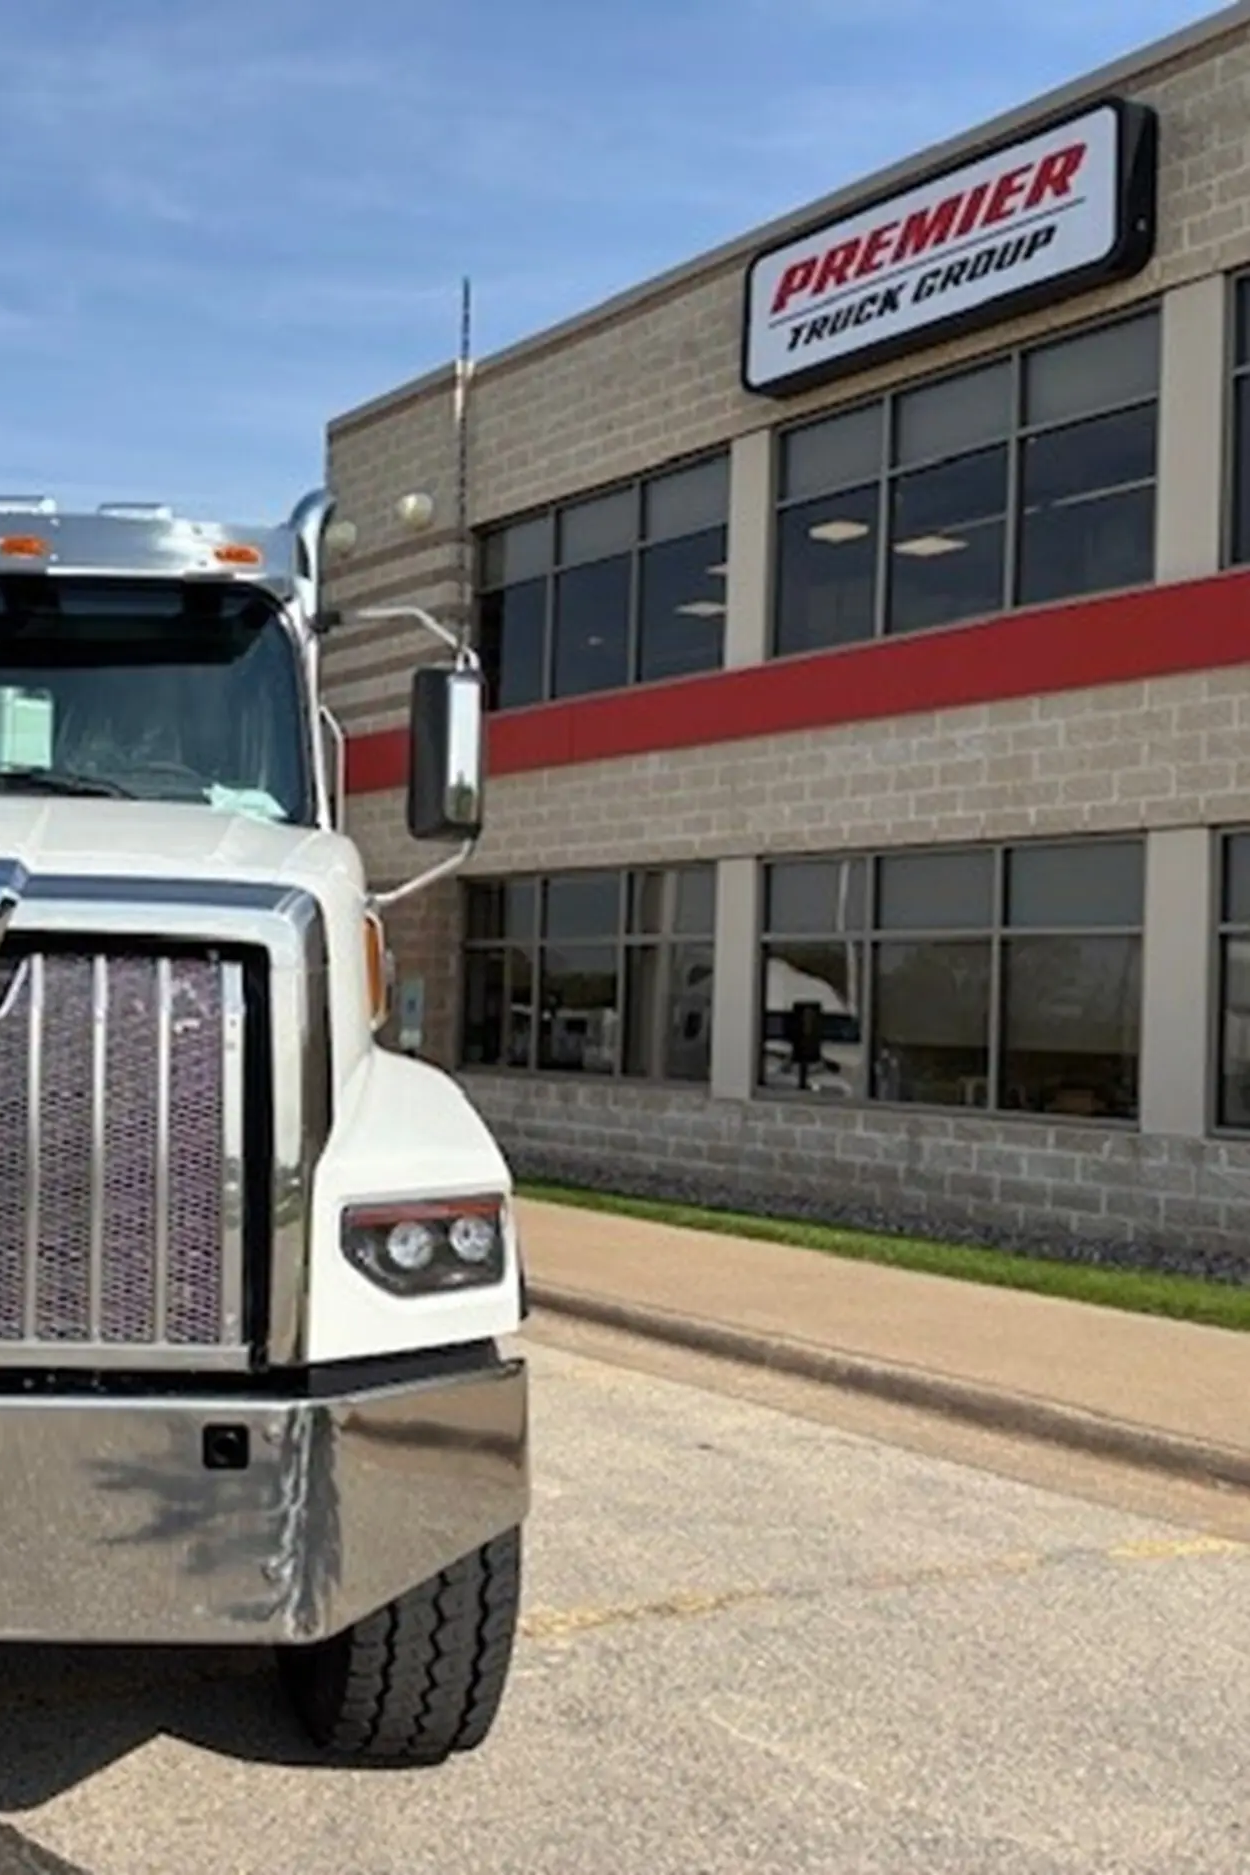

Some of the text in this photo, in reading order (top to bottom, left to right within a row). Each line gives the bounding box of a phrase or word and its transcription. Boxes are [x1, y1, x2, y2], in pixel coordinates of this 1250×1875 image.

[770, 142, 1087, 314] PREMIER
[787, 225, 1057, 351] TRUCK GROUP
